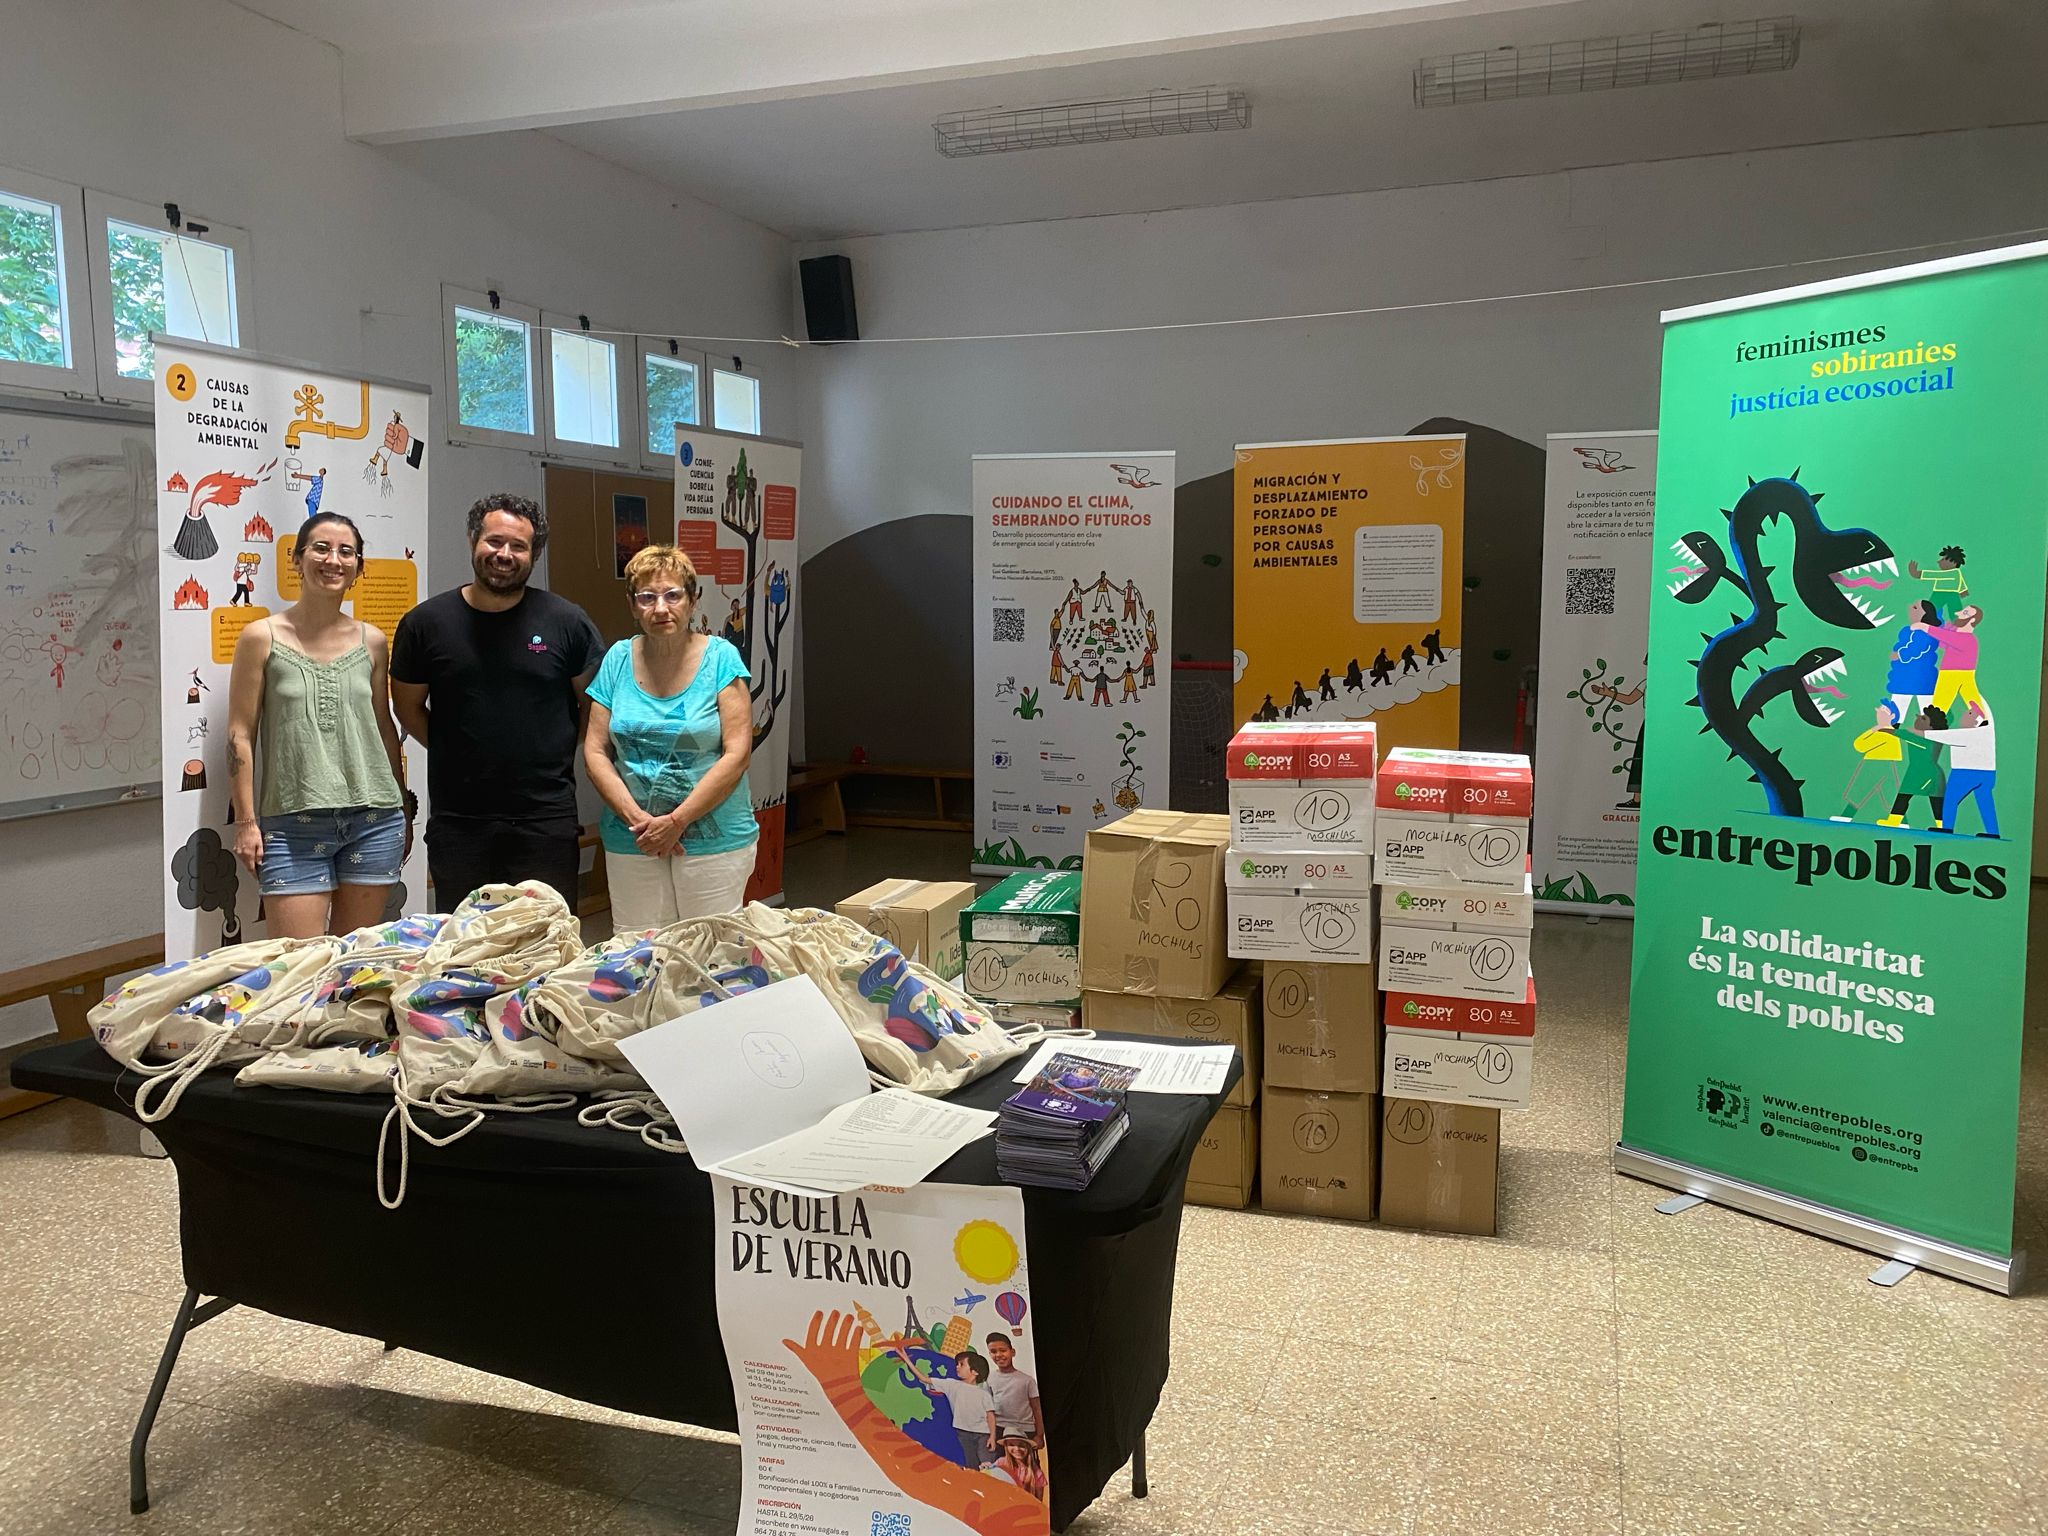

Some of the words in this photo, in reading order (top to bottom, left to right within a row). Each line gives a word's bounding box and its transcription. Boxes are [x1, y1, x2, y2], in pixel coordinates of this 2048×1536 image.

[1736, 324, 1886, 363] feminismes
[1811, 341, 1956, 378] sobiranies
[177, 374, 186, 391] 2
[206, 378, 249, 395] CAUSAS
[1730, 385, 1819, 419] justícia
[1825, 367, 1954, 402] ecosocial
[213, 398, 228, 409] DE
[231, 401, 244, 412] LA
[187, 412, 268, 433] DEGRADACIÓN
[198, 433, 259, 449] AMBIENTAL
[690, 470, 714, 480] CUENCIAS
[1253, 473, 1327, 488] MIGRACIÓN
[1332, 473, 1341, 484] Y
[689, 482, 706, 491] SOBRE
[1587, 490, 1628, 499] exposición
[684, 494, 695, 502] VIDA
[697, 494, 703, 502] DE
[704, 495, 713, 503] LAS
[992, 496, 1062, 508] CUIDANDO
[1068, 496, 1083, 508] EL
[1088, 496, 1134, 510] CLIMA,
[1253, 489, 1368, 504] DESPLAZAMIENTO
[686, 506, 714, 515] PERSONAS
[1567, 500, 1609, 510] disponibles
[992, 514, 1080, 526] SEMBRANDO
[1085, 514, 1151, 526] FUTUROS
[1253, 508, 1316, 520] FORZADO
[1320, 507, 1337, 517] DE
[1576, 510, 1606, 518] acceder
[1614, 510, 1621, 518] la
[1623, 509, 1651, 517] versión
[1253, 524, 1323, 536] PERSONAS
[1567, 521, 1584, 529] abre
[1573, 530, 1618, 539] notificación
[1627, 530, 1653, 538] enlace
[1001, 540, 1036, 549] emergencia
[1061, 539, 1095, 547] catástrofes
[1253, 541, 1281, 552] POR
[1286, 540, 1334, 551] CAUSAS
[1253, 555, 1338, 568] AMBIENTALES
[1259, 756, 1293, 766] COPY
[1308, 753, 1331, 767] 80
[1338, 753, 1351, 761] A3
[1411, 787, 1447, 799] COPY
[1463, 788, 1487, 803] 80
[1495, 790, 1508, 798] A3
[1255, 810, 1275, 818] APP
[1303, 796, 1339, 824] 10
[1602, 814, 1640, 823] GRACIAS
[1402, 845, 1424, 854] APP
[1478, 834, 1510, 861] 10
[1652, 824, 2007, 900] entrepobles
[1255, 865, 1288, 875] COPY
[1304, 864, 1327, 878] 80
[1411, 897, 1446, 908] COPY
[1463, 899, 1487, 914] 80
[1253, 919, 1273, 928] APP
[1304, 912, 1343, 939] 10
[1139, 930, 1203, 959] MOCHILAS
[1701, 916, 1736, 945] La
[1742, 928, 1925, 978] solidaritat
[1405, 952, 1426, 961] APP
[1475, 945, 1505, 974] 10
[974, 956, 1001, 985] 10
[1015, 970, 1069, 987] MOCHILAS
[1688, 946, 1722, 973] és
[1728, 952, 1755, 981] la
[1761, 961, 1936, 1016] tendressa
[1278, 985, 1299, 1010] 10
[1418, 1005, 1454, 1017] COPY
[1469, 1008, 1493, 1022] 80
[1500, 1010, 1513, 1018] A3
[1716, 985, 1781, 1018] dels
[1787, 1002, 1905, 1045] pobles
[1277, 1043, 1336, 1059] MOCHILAS
[1410, 1060, 1432, 1069] APP
[1482, 1049, 1506, 1078] 10
[1398, 1106, 1425, 1134] 10
[1762, 1094, 1923, 1145] www.entrepobles.org
[1300, 1119, 1327, 1146] 10
[1762, 1109, 1921, 1160] valencia@entrepobles.org
[1776, 1128, 1840, 1152] @entrepueblos
[1868, 1153, 1919, 1173] @entrepbs
[731, 1186, 872, 1239] ESCUELA
[732, 1231, 773, 1273] DE
[783, 1237, 911, 1290] VERANO
[778, 1443, 801, 1451] mucho
[759, 1456, 785, 1465] TARIFAS
[758, 1473, 799, 1485] Bonificación
[834, 1483, 861, 1493] Familias
[756, 1508, 779, 1517] HASTA
